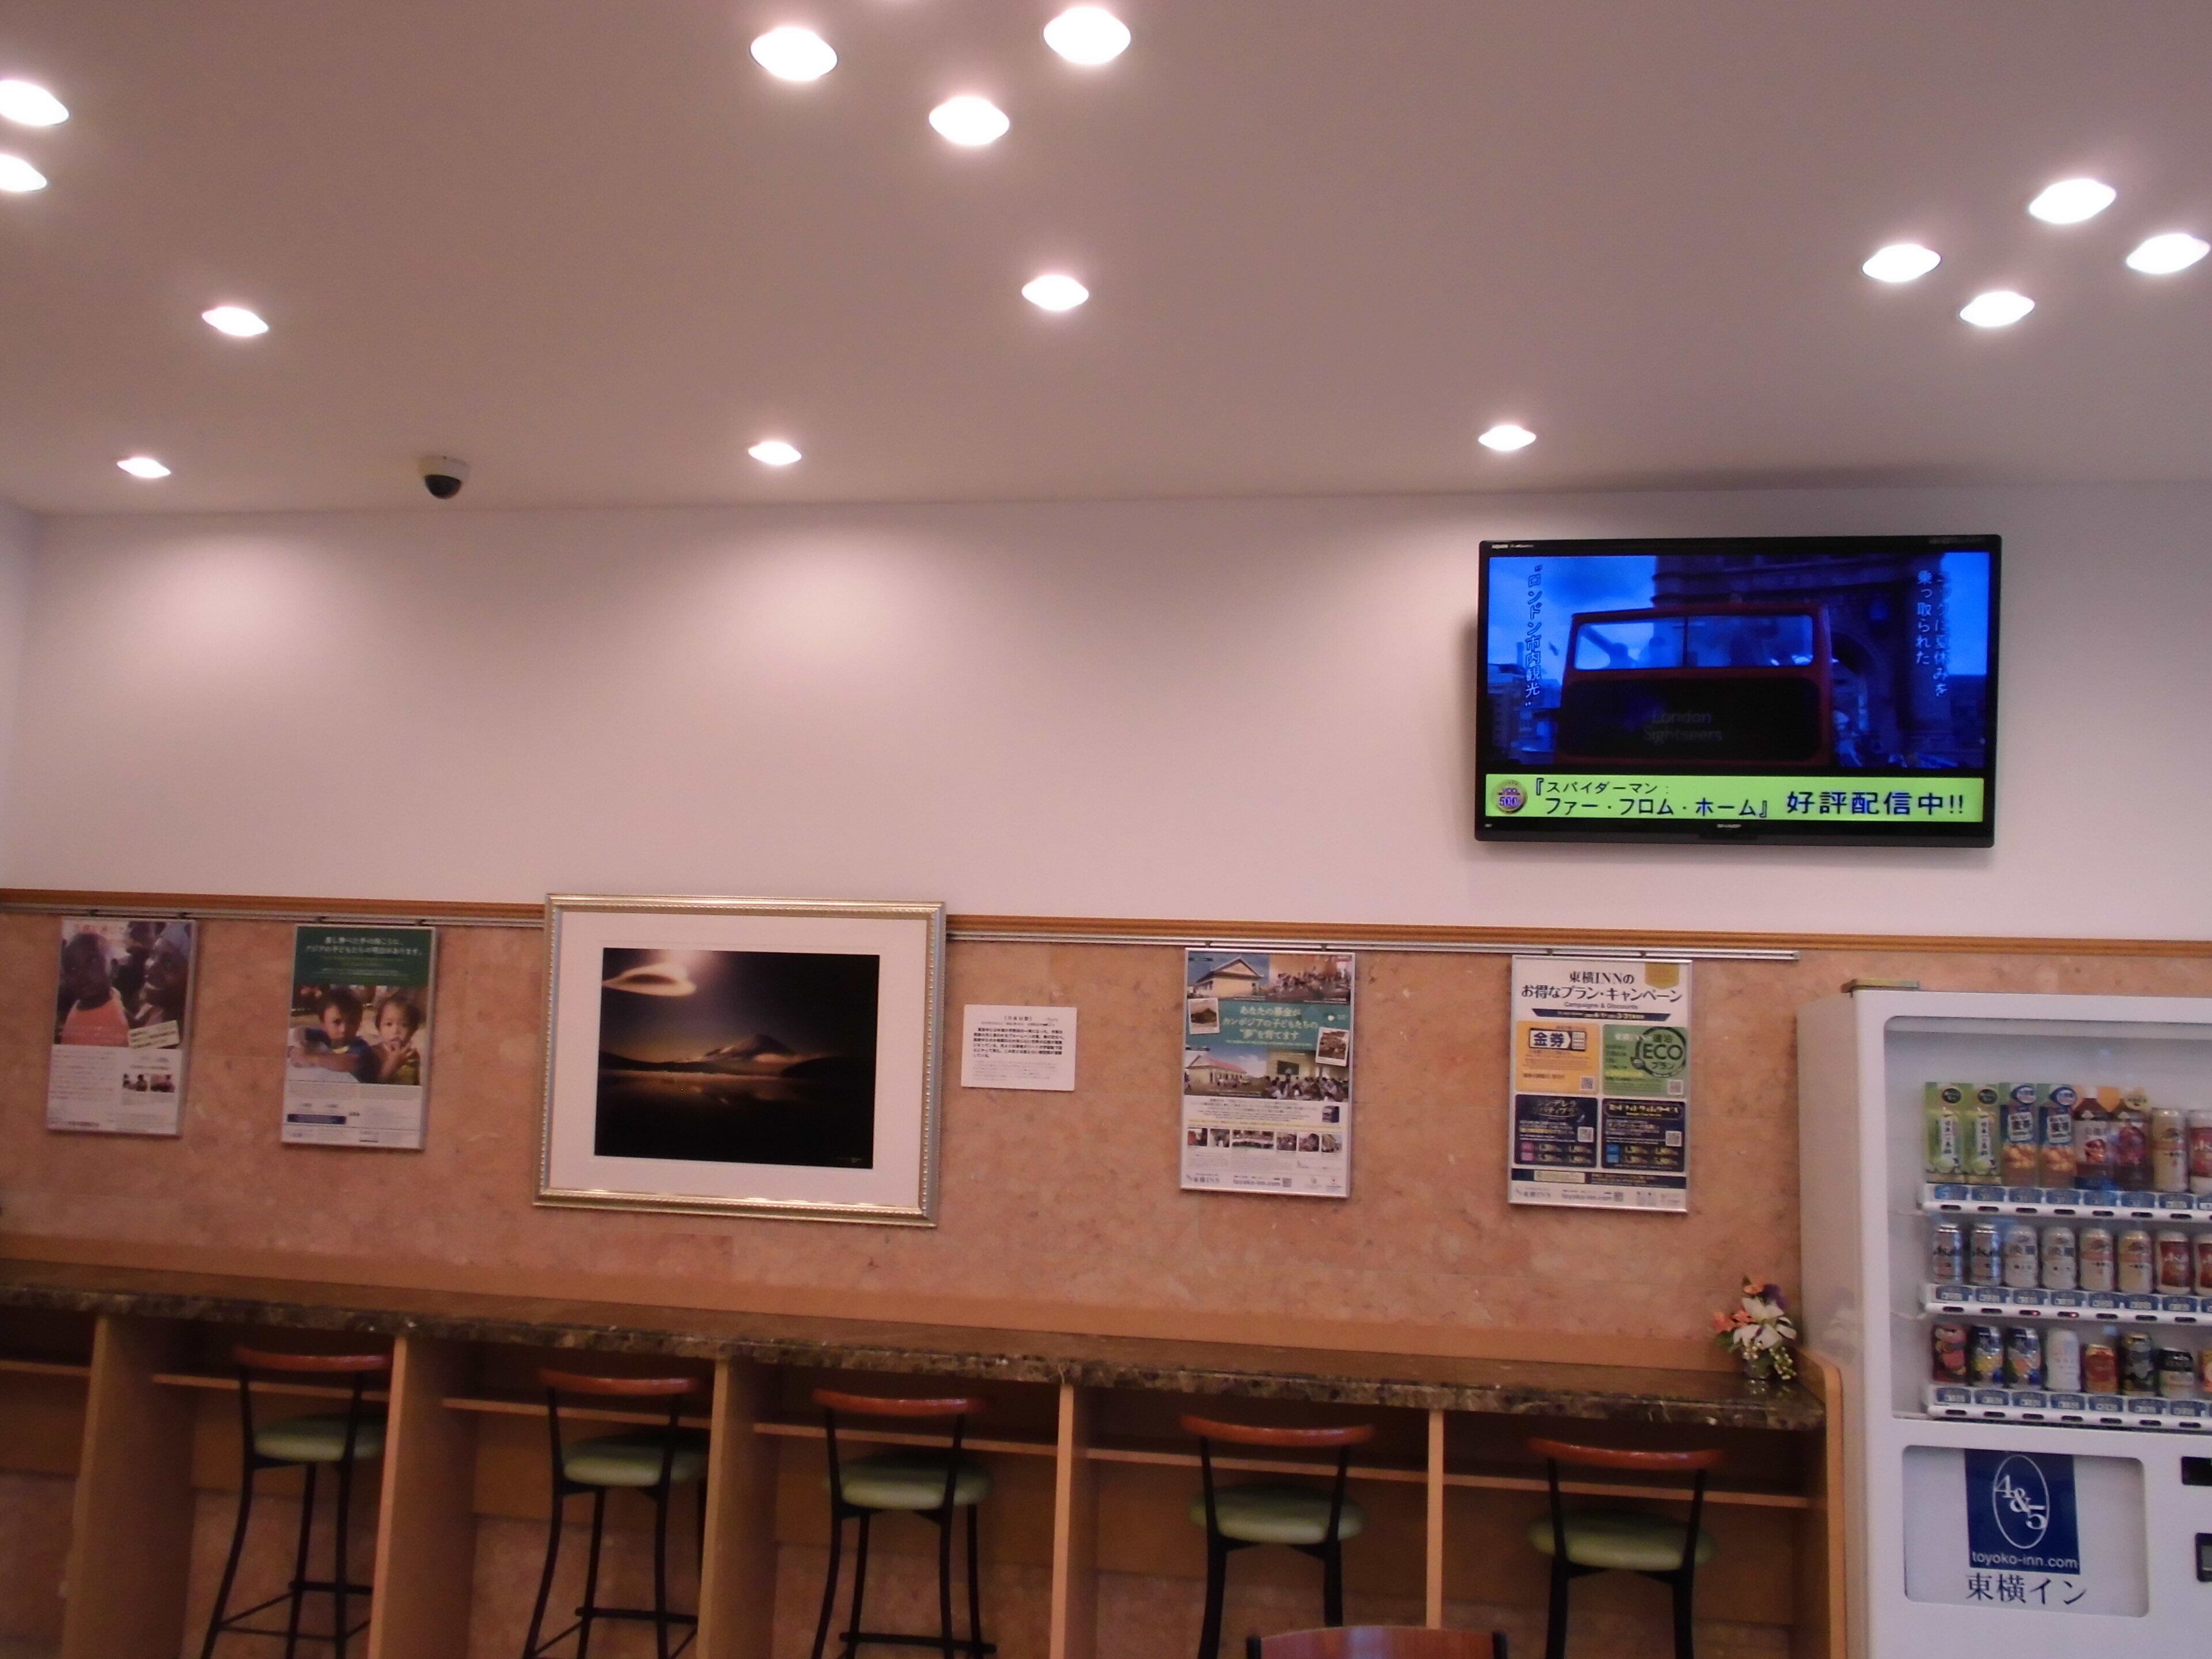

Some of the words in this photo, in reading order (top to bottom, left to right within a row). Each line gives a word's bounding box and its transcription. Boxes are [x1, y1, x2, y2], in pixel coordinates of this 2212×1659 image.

[1787, 791, 1963, 815] 好評配信中!!
[1569, 971, 1634, 984] 東横INNの
[1521, 984, 1683, 1003] お得なプラン・キャンペーン
[1533, 1032, 1564, 1047] 金券
[1643, 1044, 1683, 1060] ECO
[1972, 1551, 2078, 1569] toyoko-inn.com
[1965, 1572, 2087, 1605] 東横イン
